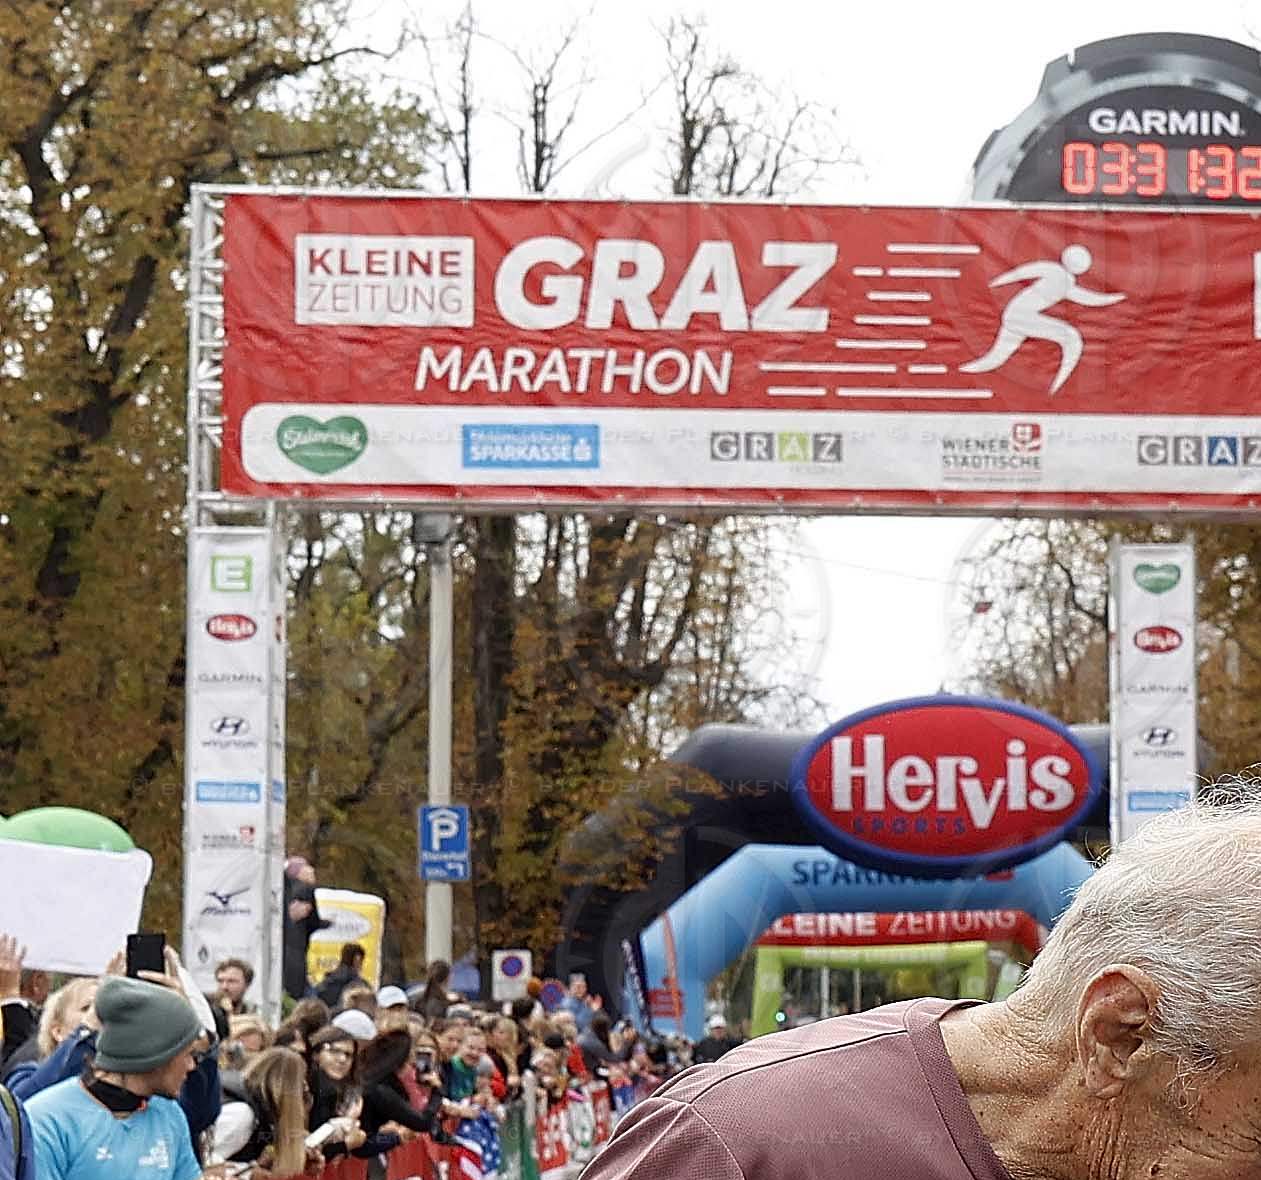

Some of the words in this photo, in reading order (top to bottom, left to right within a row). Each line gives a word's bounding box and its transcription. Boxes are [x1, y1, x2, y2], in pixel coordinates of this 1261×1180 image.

[1089, 109, 1240, 136] GARMIN
[307, 247, 463, 278] KLEINE
[307, 281, 464, 316] ZEITUNG
[494, 235, 838, 332] GRAZ
[414, 345, 733, 396] MARATHON
[711, 431, 842, 462] GRAZ
[831, 733, 1076, 830] Hervis
[853, 815, 967, 834] SPORTS
[764, 912, 877, 937] LEINE
[889, 908, 1018, 936] ZEITUNG
